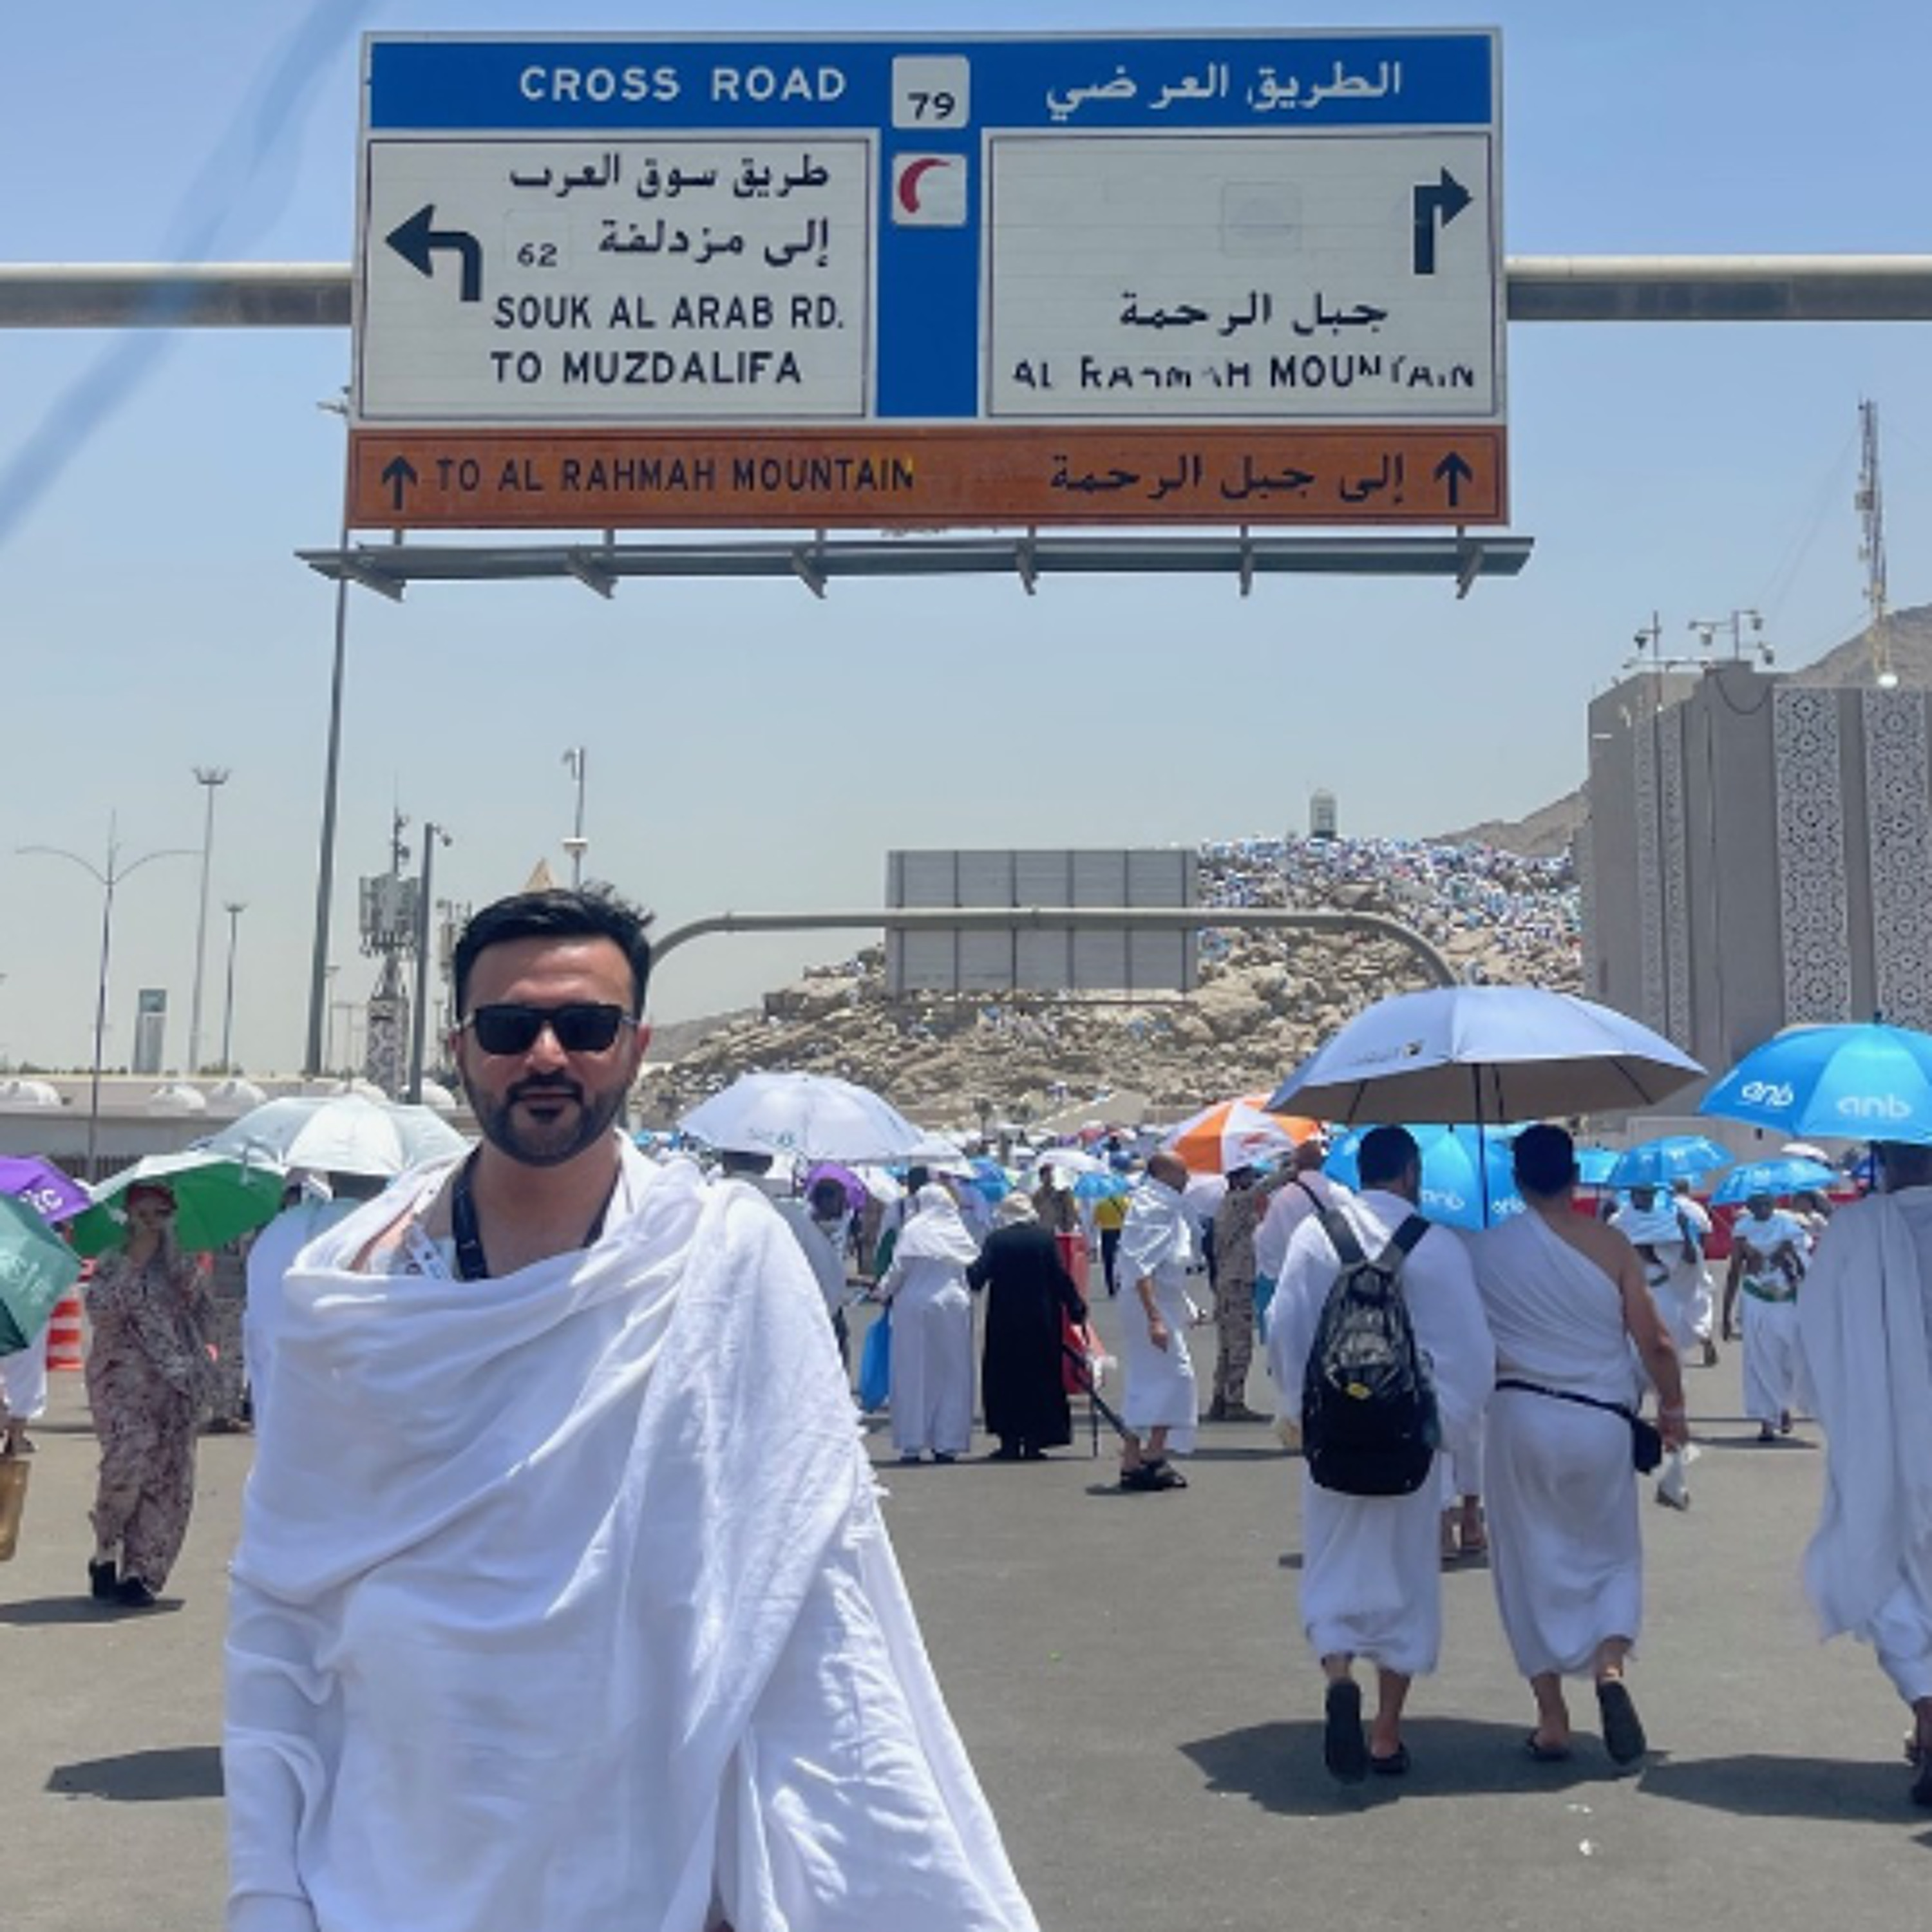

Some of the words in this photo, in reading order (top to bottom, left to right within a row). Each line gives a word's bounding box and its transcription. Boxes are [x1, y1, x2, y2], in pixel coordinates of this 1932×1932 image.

[520, 65, 681, 102] CROSS
[712, 66, 846, 101] ROAD
[1247, 61, 1401, 111] الطريق
[909, 91, 955, 120] 79
[636, 157, 717, 199] سوق
[733, 153, 829, 198] طريق
[516, 242, 558, 267] 62
[598, 218, 744, 263] مزدلفة
[763, 217, 829, 268] إلى
[493, 295, 592, 329] SOUK
[609, 296, 656, 329] AL
[671, 295, 774, 329] ARAB
[790, 294, 844, 329] RD.
[1119, 290, 1272, 337] الرحمة
[1293, 292, 1388, 337] جبل
[490, 350, 542, 384] TO
[562, 350, 802, 384] MUZDALIFA
[436, 457, 480, 492] TO
[498, 459, 544, 492] AL
[561, 458, 715, 492] RAHMAH
[732, 458, 914, 492] MOUNTAIN
[1220, 455, 1316, 500] جبل
[1339, 453, 1404, 505] إلى
[1837, 1093, 1912, 1118] anb
